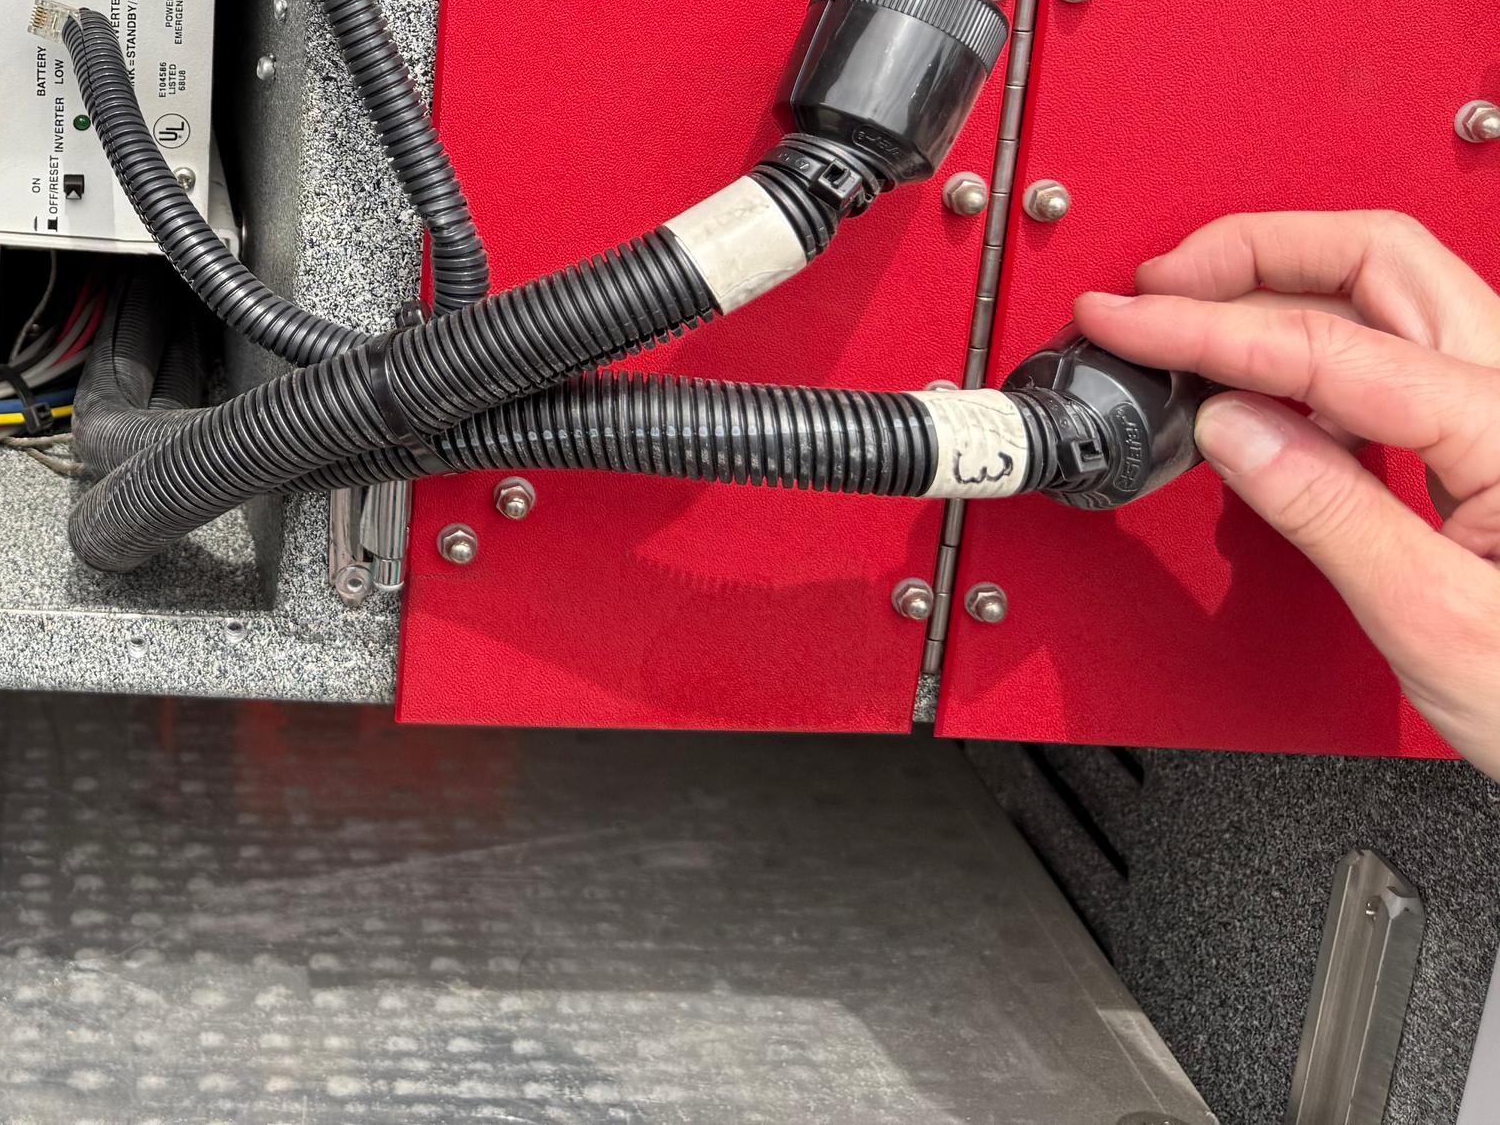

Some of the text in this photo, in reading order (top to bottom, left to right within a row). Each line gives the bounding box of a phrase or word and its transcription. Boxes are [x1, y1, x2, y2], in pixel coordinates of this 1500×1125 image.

[37, 46, 46, 96] BATTERY
[54, 59, 64, 84] LOW
[159, 62, 167, 97] E104586
[54, 97, 64, 152] INVERTER
[32, 178, 40, 193] ON
[49, 156, 58, 214] OFF/RESET
